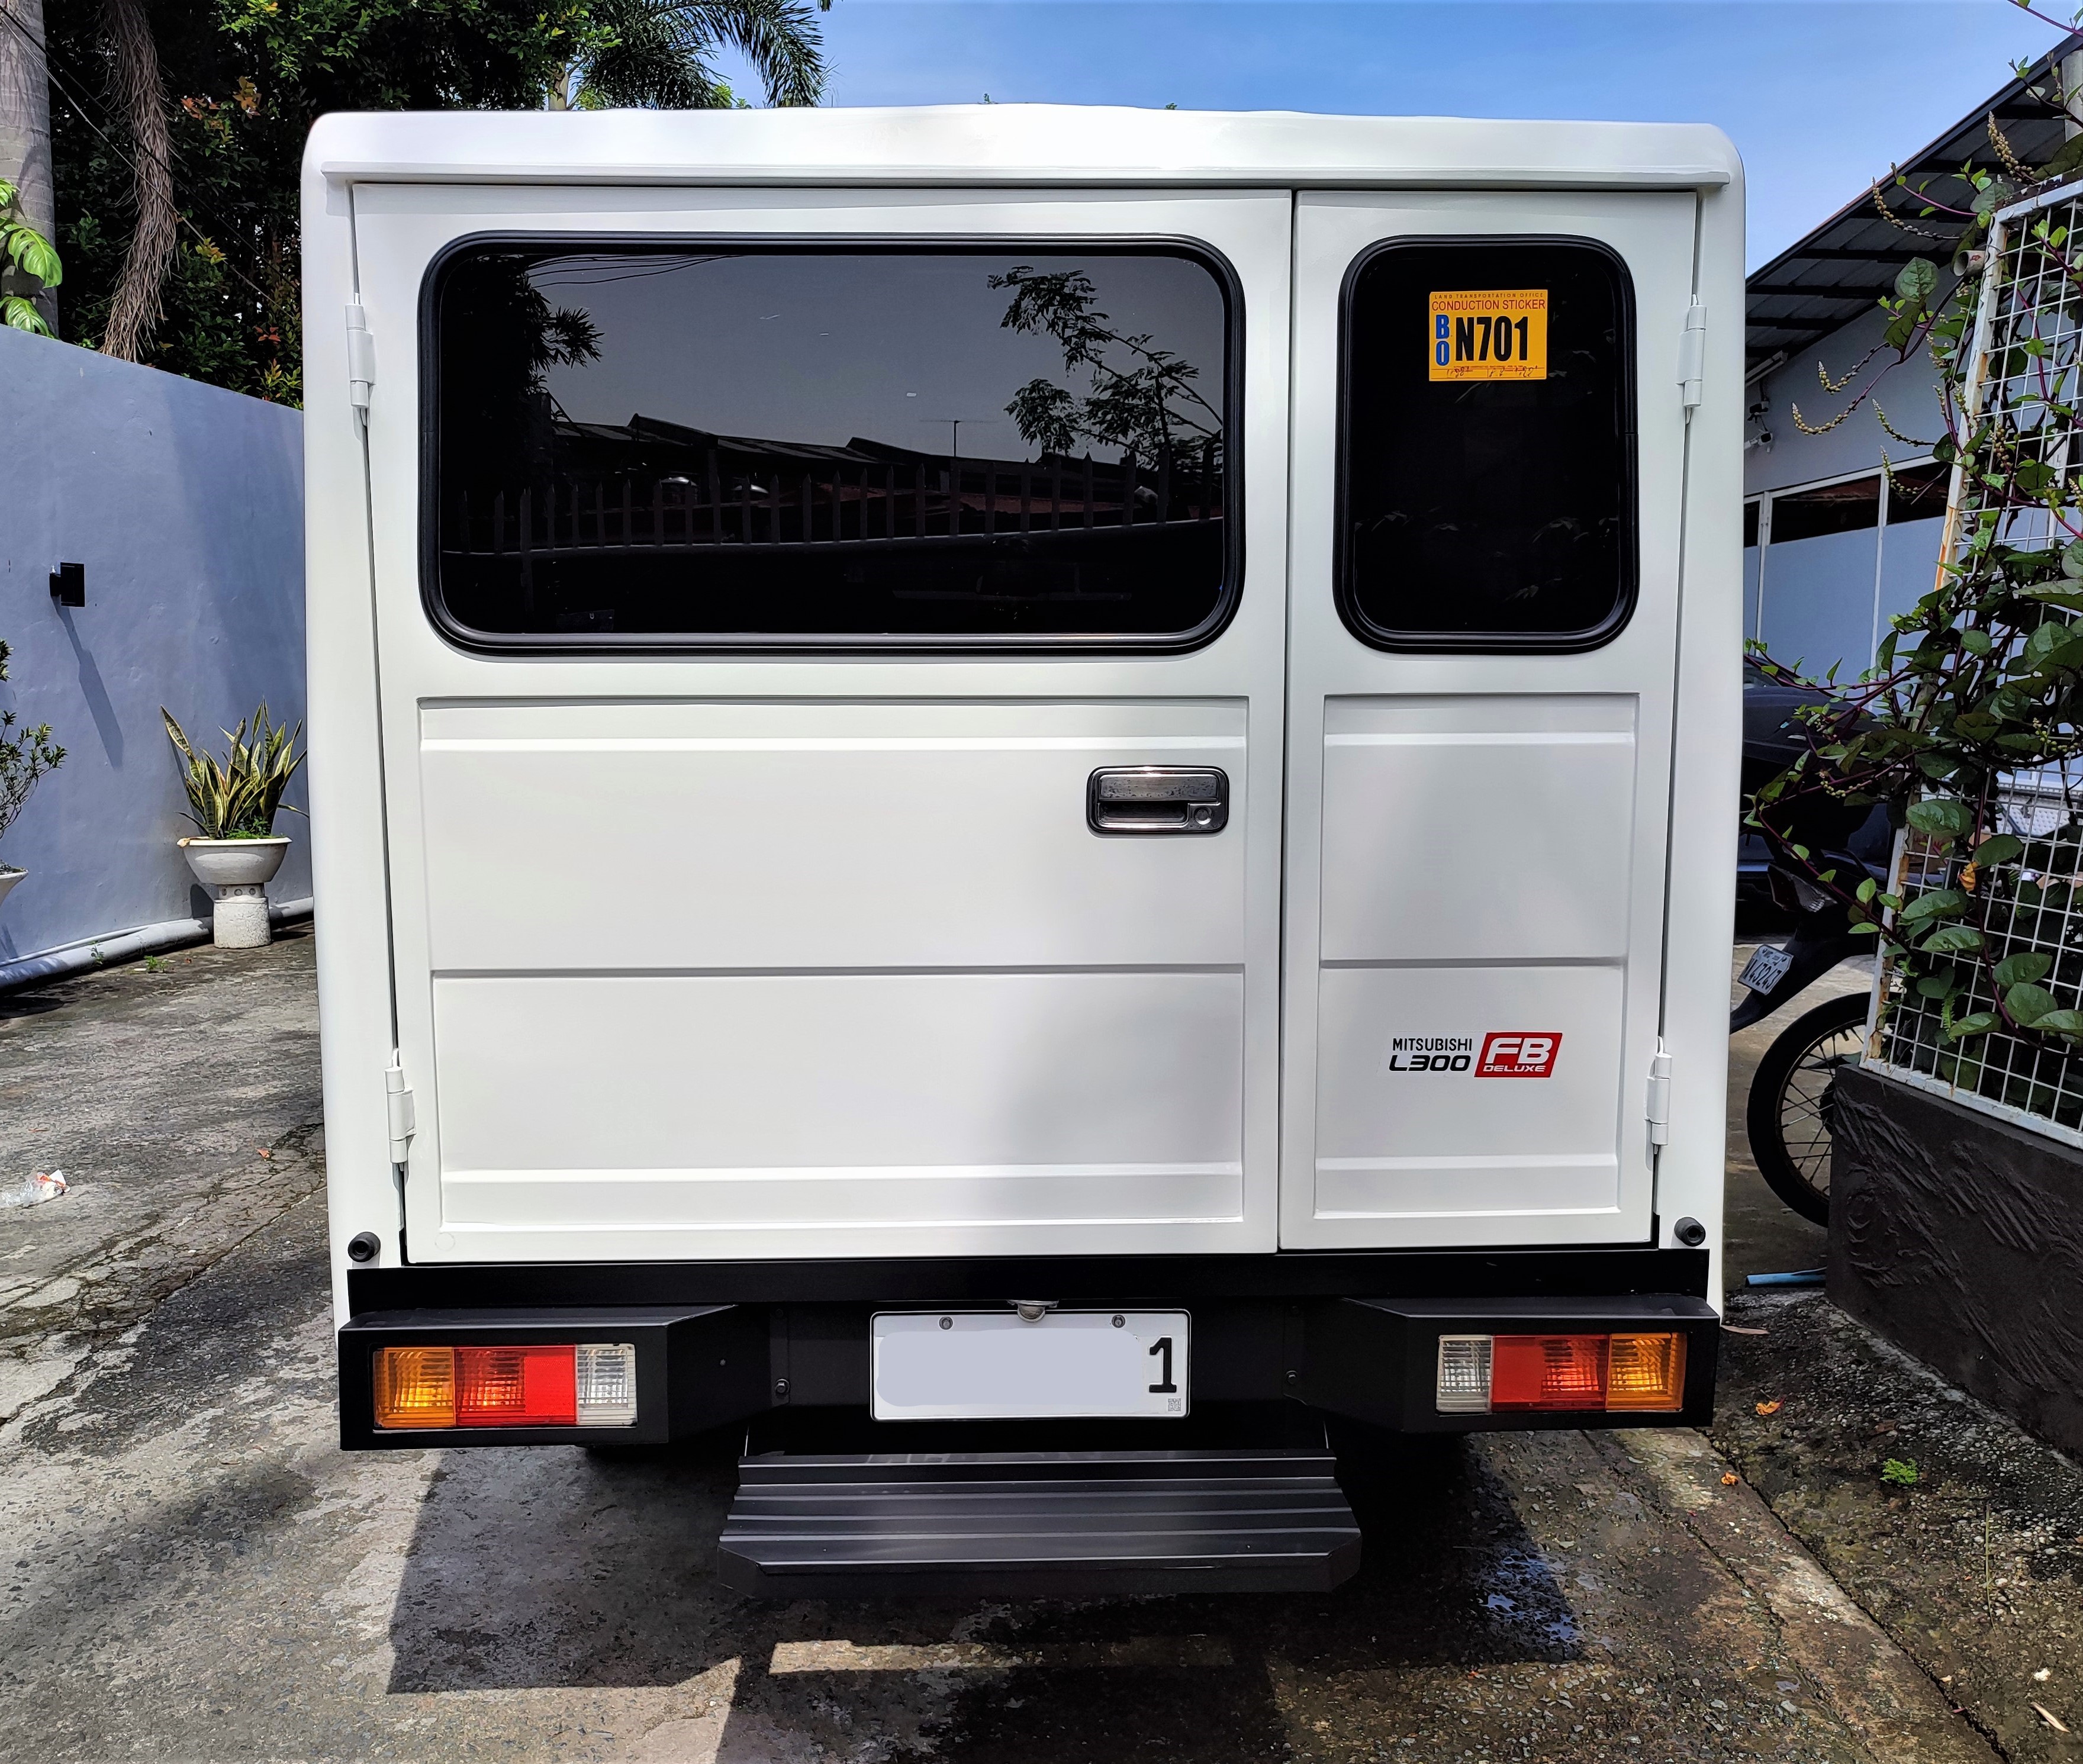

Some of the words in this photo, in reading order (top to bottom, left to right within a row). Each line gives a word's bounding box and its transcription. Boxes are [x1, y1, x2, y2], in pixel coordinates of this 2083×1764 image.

[1431, 300, 1499, 311] CONDUCTION
[1502, 299, 1546, 310] STICKER
[1455, 316, 1528, 362] N701
[1392, 1038, 1472, 1051] MITSUBISHI
[1485, 1037, 1553, 1064] FB
[1389, 1055, 1472, 1071] L300
[1148, 1337, 1177, 1393] 1
